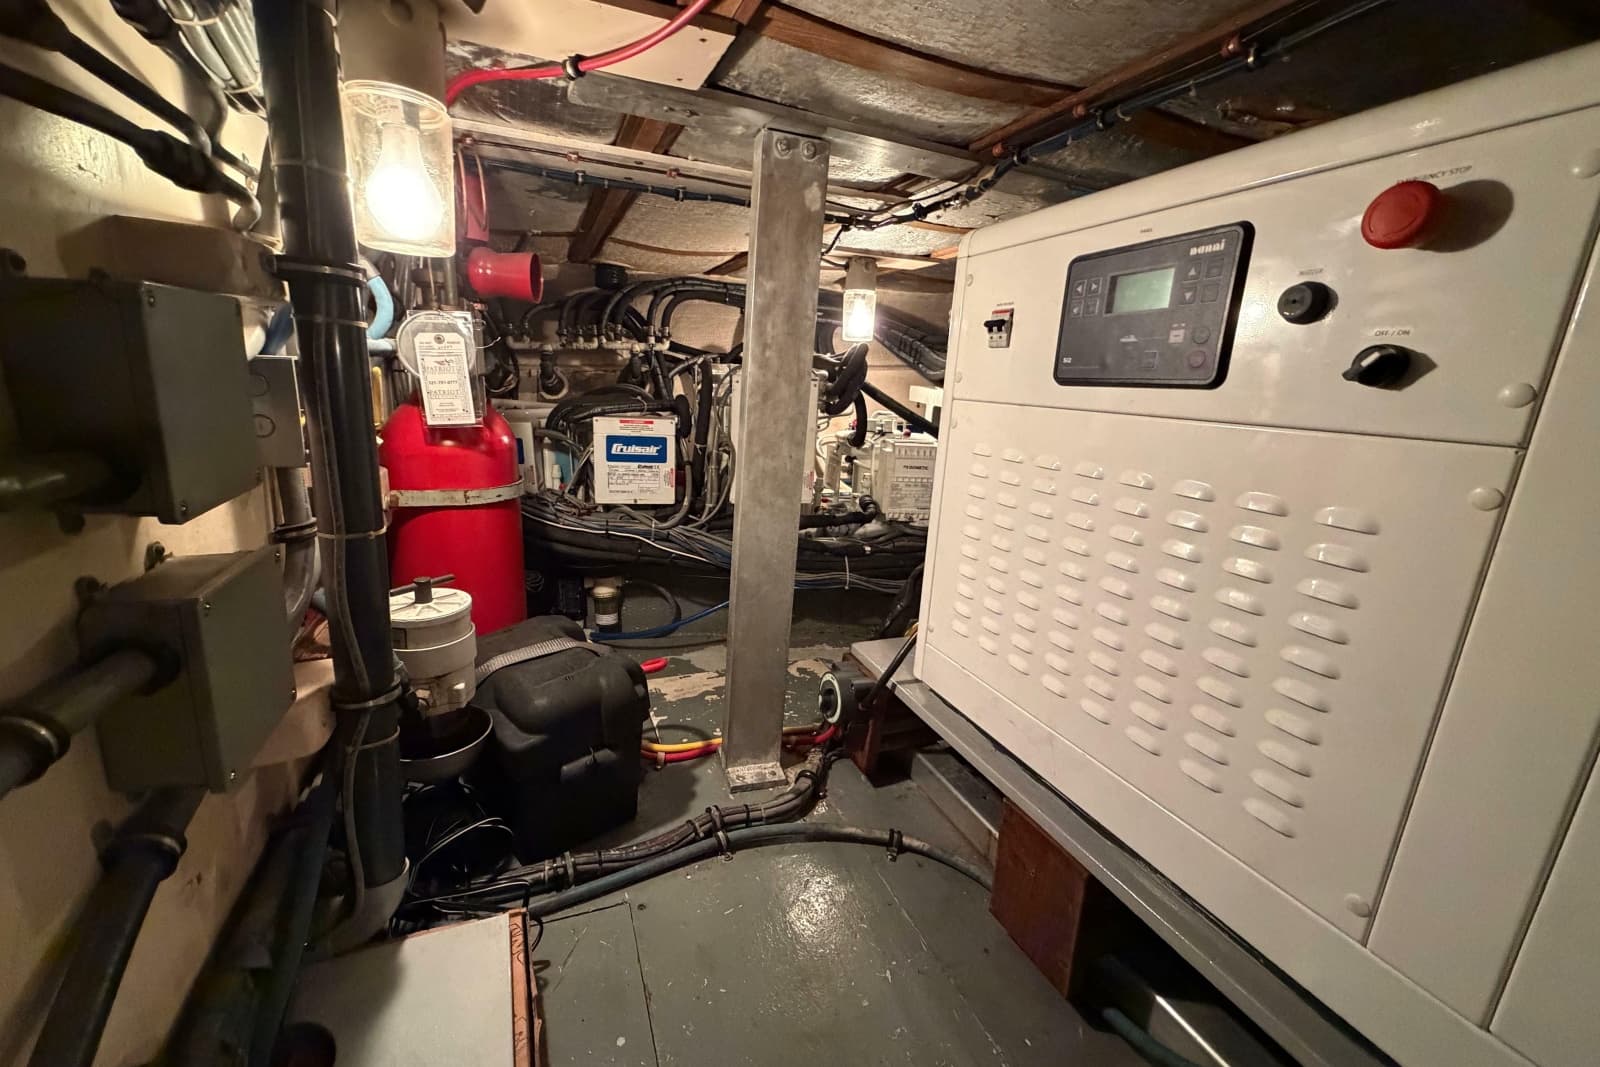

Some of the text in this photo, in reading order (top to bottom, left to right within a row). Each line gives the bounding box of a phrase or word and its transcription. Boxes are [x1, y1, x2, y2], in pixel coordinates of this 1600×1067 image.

[1449, 165, 1473, 175] STOP
[1374, 329, 1389, 337] OFF
[1397, 329, 1411, 337] ON
[611, 443, 661, 456] Cruisair
